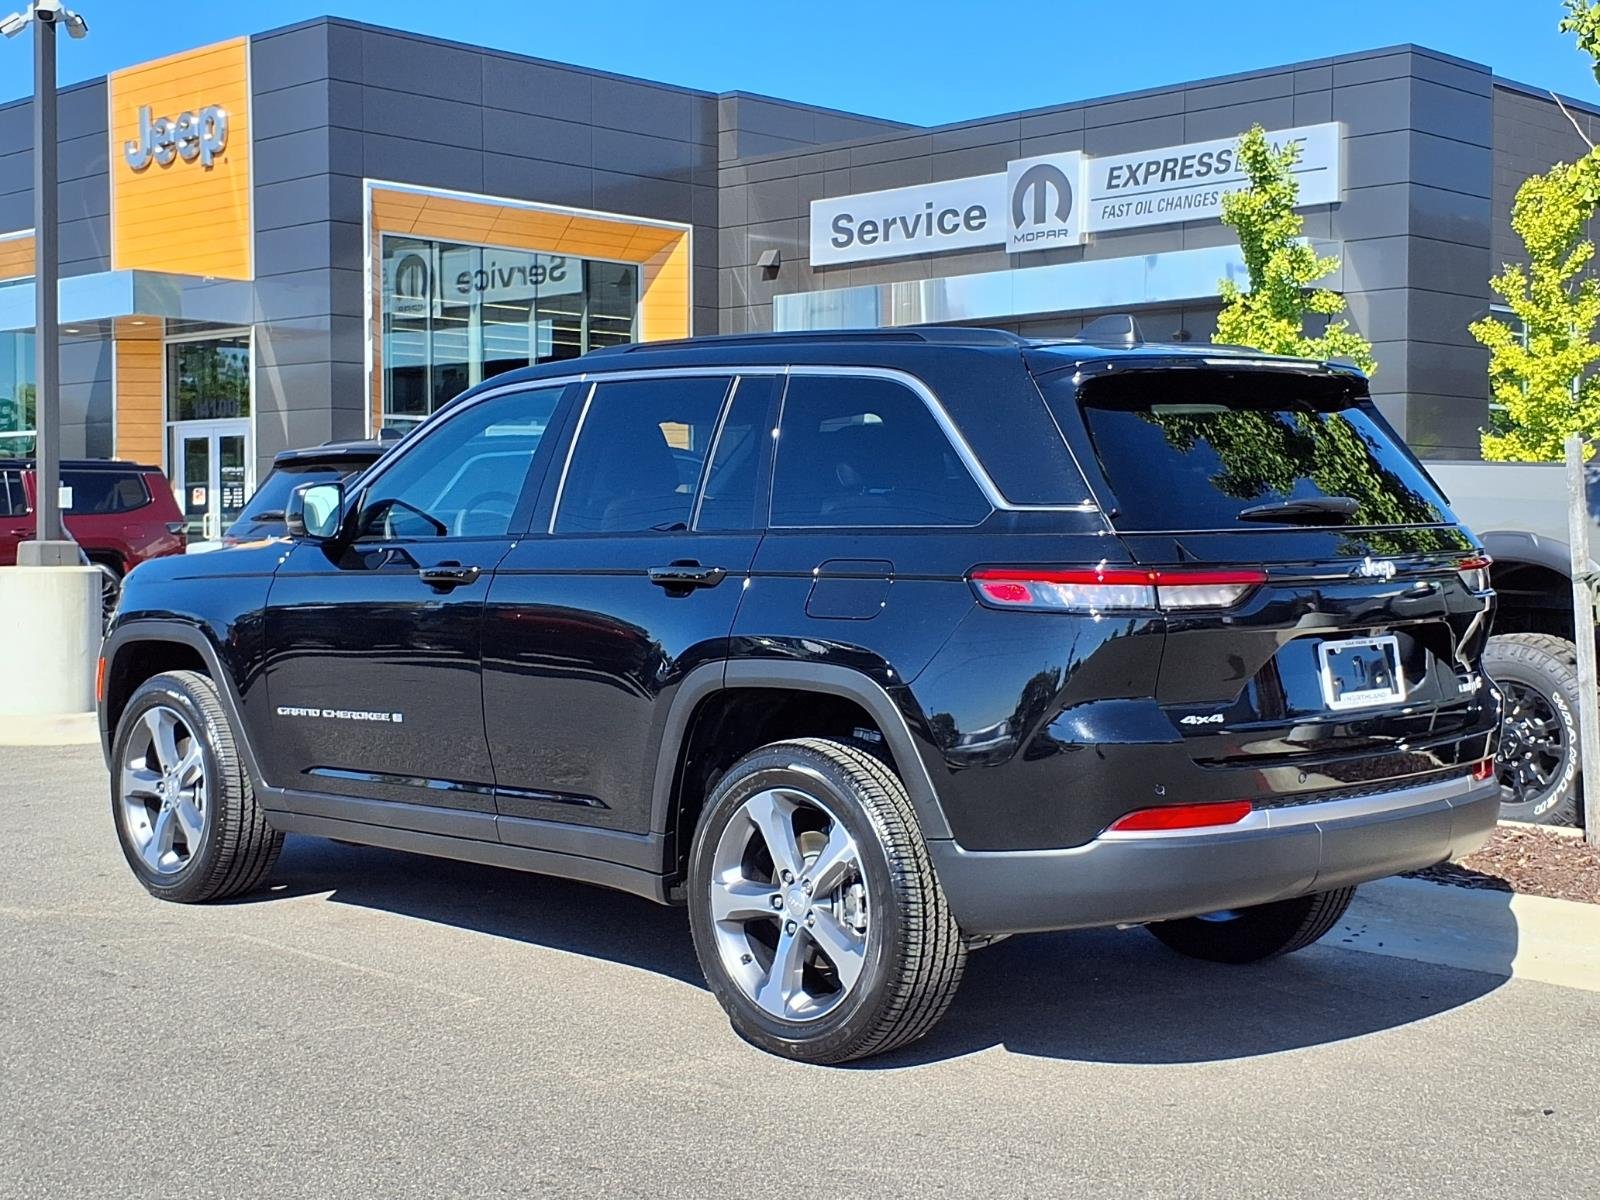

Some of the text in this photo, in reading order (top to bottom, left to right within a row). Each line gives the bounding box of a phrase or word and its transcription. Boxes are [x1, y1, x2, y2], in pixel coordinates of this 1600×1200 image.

[124, 105, 229, 170] Jeep
[1102, 203, 1131, 219] FAST
[1135, 199, 1153, 216] OIL
[1157, 191, 1219, 212] CHANGES
[831, 202, 987, 248] Service
[1014, 229, 1069, 244] MOPAR
[1360, 556, 1396, 579] Jeep
[277, 707, 390, 721] GRAND CHEROKEE
[1180, 714, 1224, 724] 4x4
